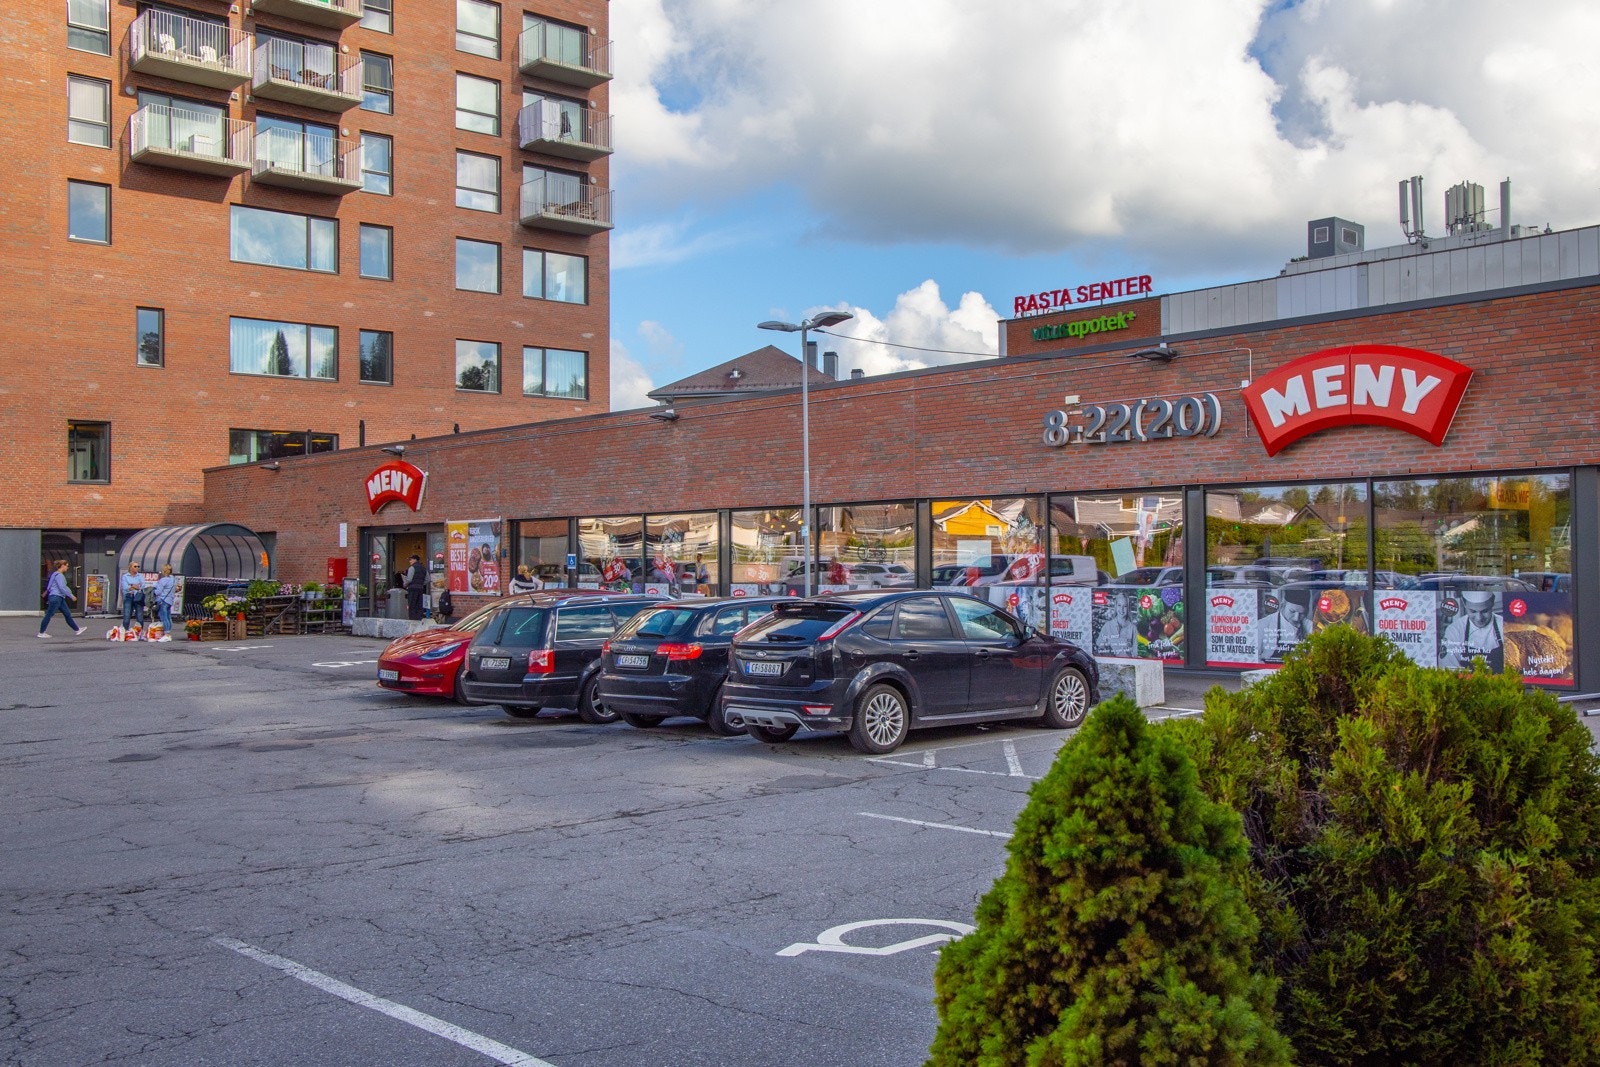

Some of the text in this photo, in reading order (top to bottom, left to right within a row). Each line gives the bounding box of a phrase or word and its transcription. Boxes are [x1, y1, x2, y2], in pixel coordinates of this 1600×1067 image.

[1014, 275, 1152, 313] RASTA SENTER
[1260, 364, 1441, 428] MENY
[368, 470, 413, 500] MENY
[450, 550, 466, 562] BESTE
[1213, 597, 1232, 605] MENY
[1383, 599, 1405, 608] MENY
[1052, 610, 1058, 618] ET
[1052, 620, 1069, 629] BREDT
[1211, 616, 1248, 625] KUNNSKAP OG
[1379, 620, 1426, 630] GODE TILBUD
[1211, 626, 1241, 634] LIDENSKAP
[1061, 632, 1082, 640] VARIERT
[1212, 636, 1246, 645] SOM GIR DEG
[1392, 632, 1422, 643] SMARTE
[1212, 645, 1225, 653] EKTE
[1227, 645, 1255, 654] MATGLEDE
[629, 655, 647, 666] 54756
[1528, 655, 1554, 667] Nystekt
[761, 663, 780, 674] 58887
[1523, 666, 1564, 678] hele dagen!
